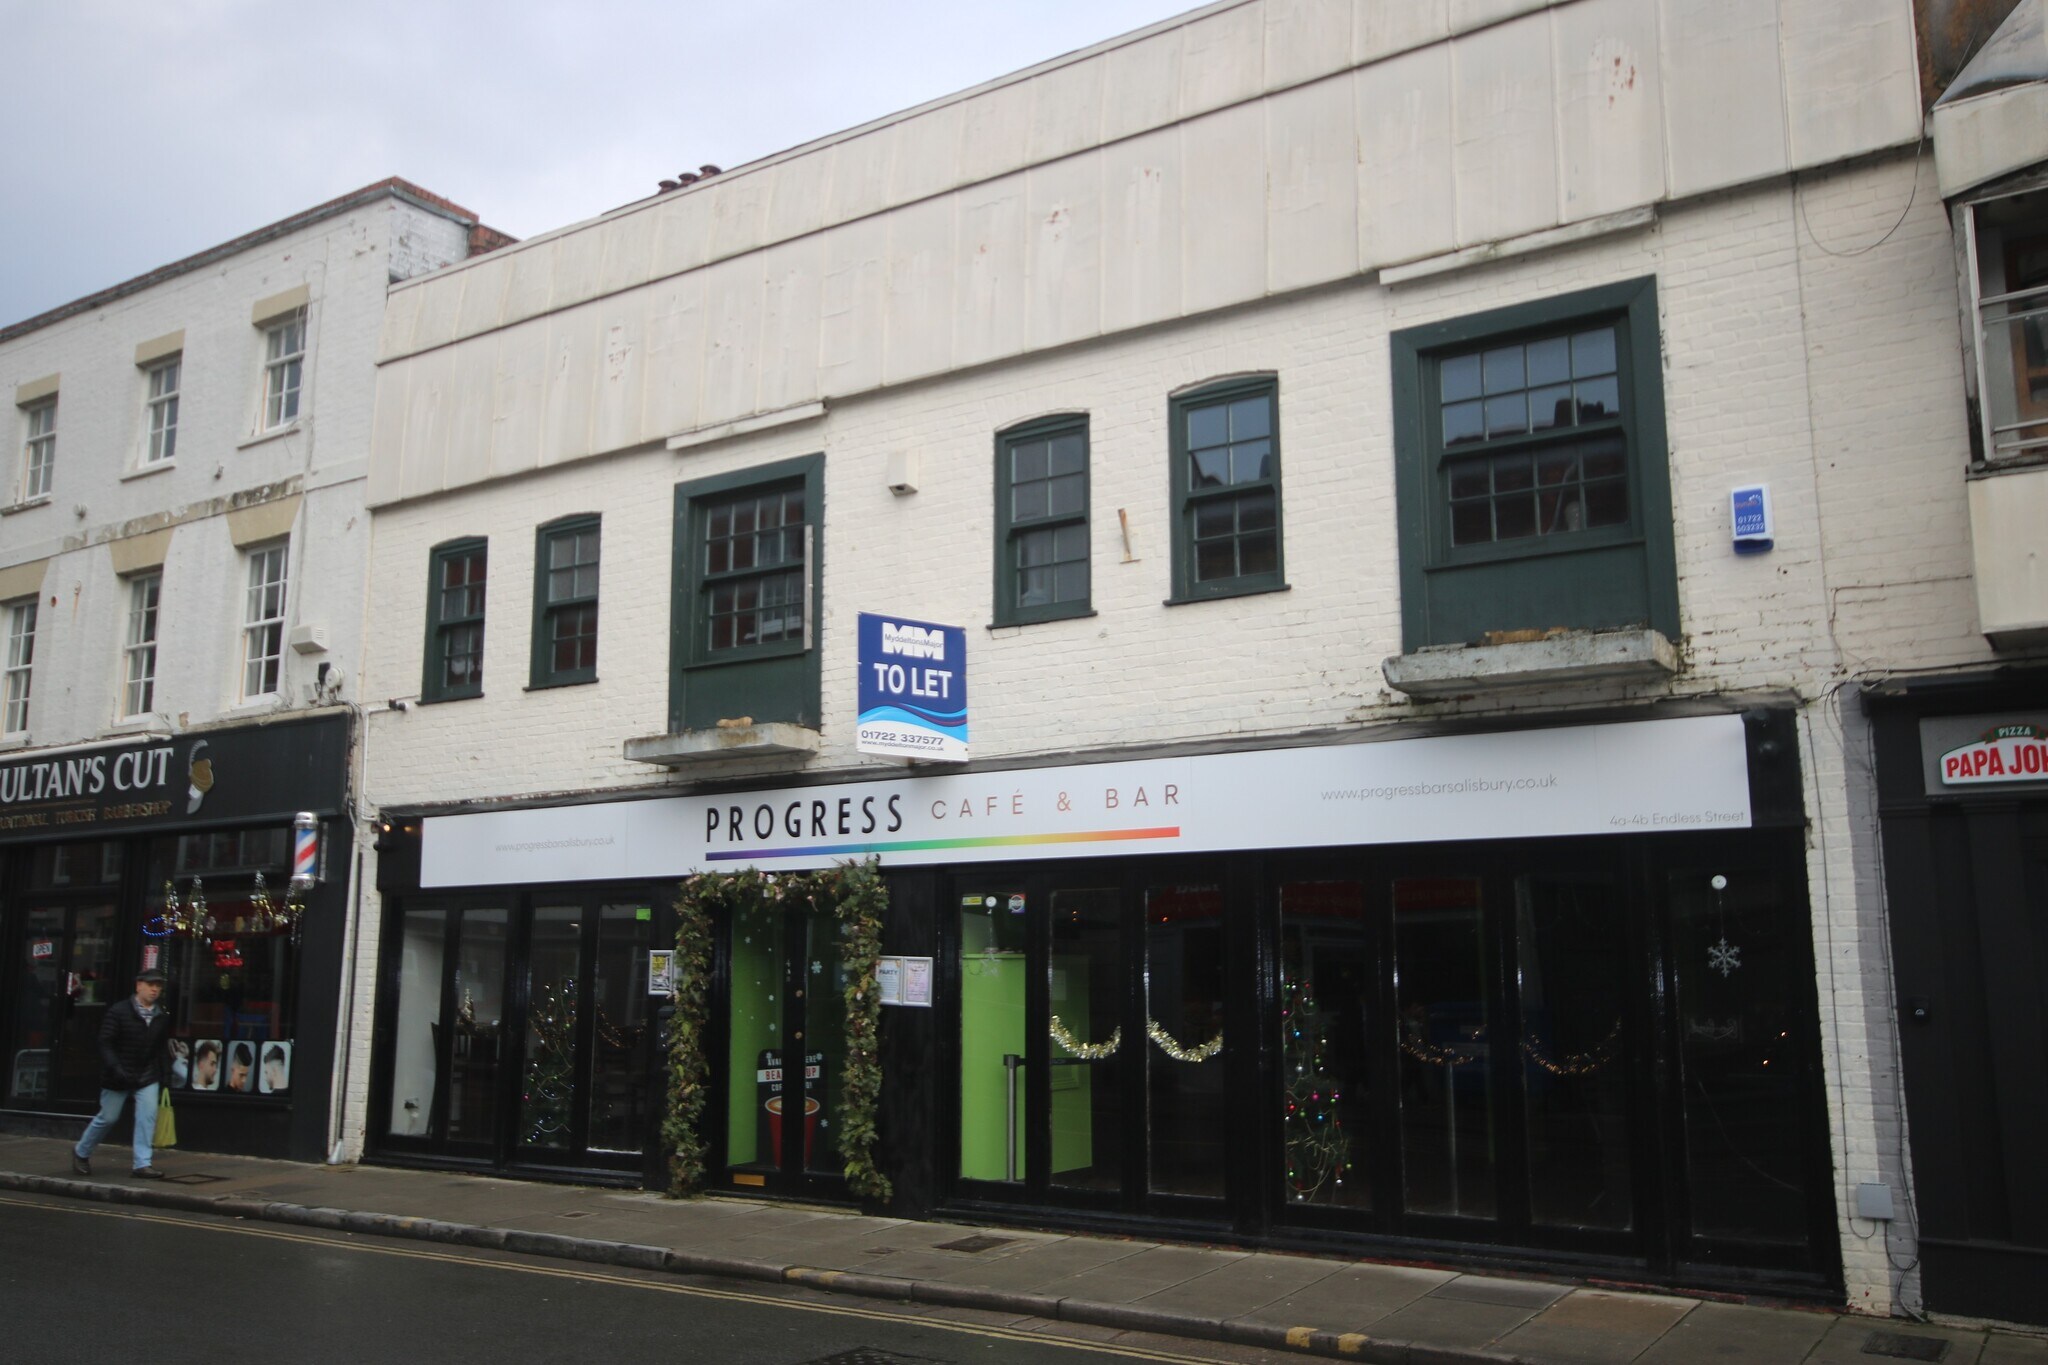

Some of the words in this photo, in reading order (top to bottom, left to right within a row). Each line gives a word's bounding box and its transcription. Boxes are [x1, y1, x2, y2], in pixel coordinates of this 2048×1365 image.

[1738, 514, 1762, 525] 01722
[874, 663, 905, 694] TO
[911, 667, 952, 698] LET
[861, 730, 897, 741] 01722
[900, 733, 944, 746] 337577
[1998, 726, 2031, 738] PIZZA
[0, 756, 106, 803] ULTAN'S
[113, 747, 174, 791] CUT
[1946, 747, 2005, 778] PAPA
[1321, 774, 1558, 801] www.progressbarsalisbury.co.uk
[706, 794, 902, 843] PROGRESS
[931, 788, 1024, 820] CAFÉ
[1056, 791, 1072, 812] &
[1105, 784, 1179, 809] BAR
[1652, 812, 1701, 825] Endless
[1705, 810, 1745, 822] Street
